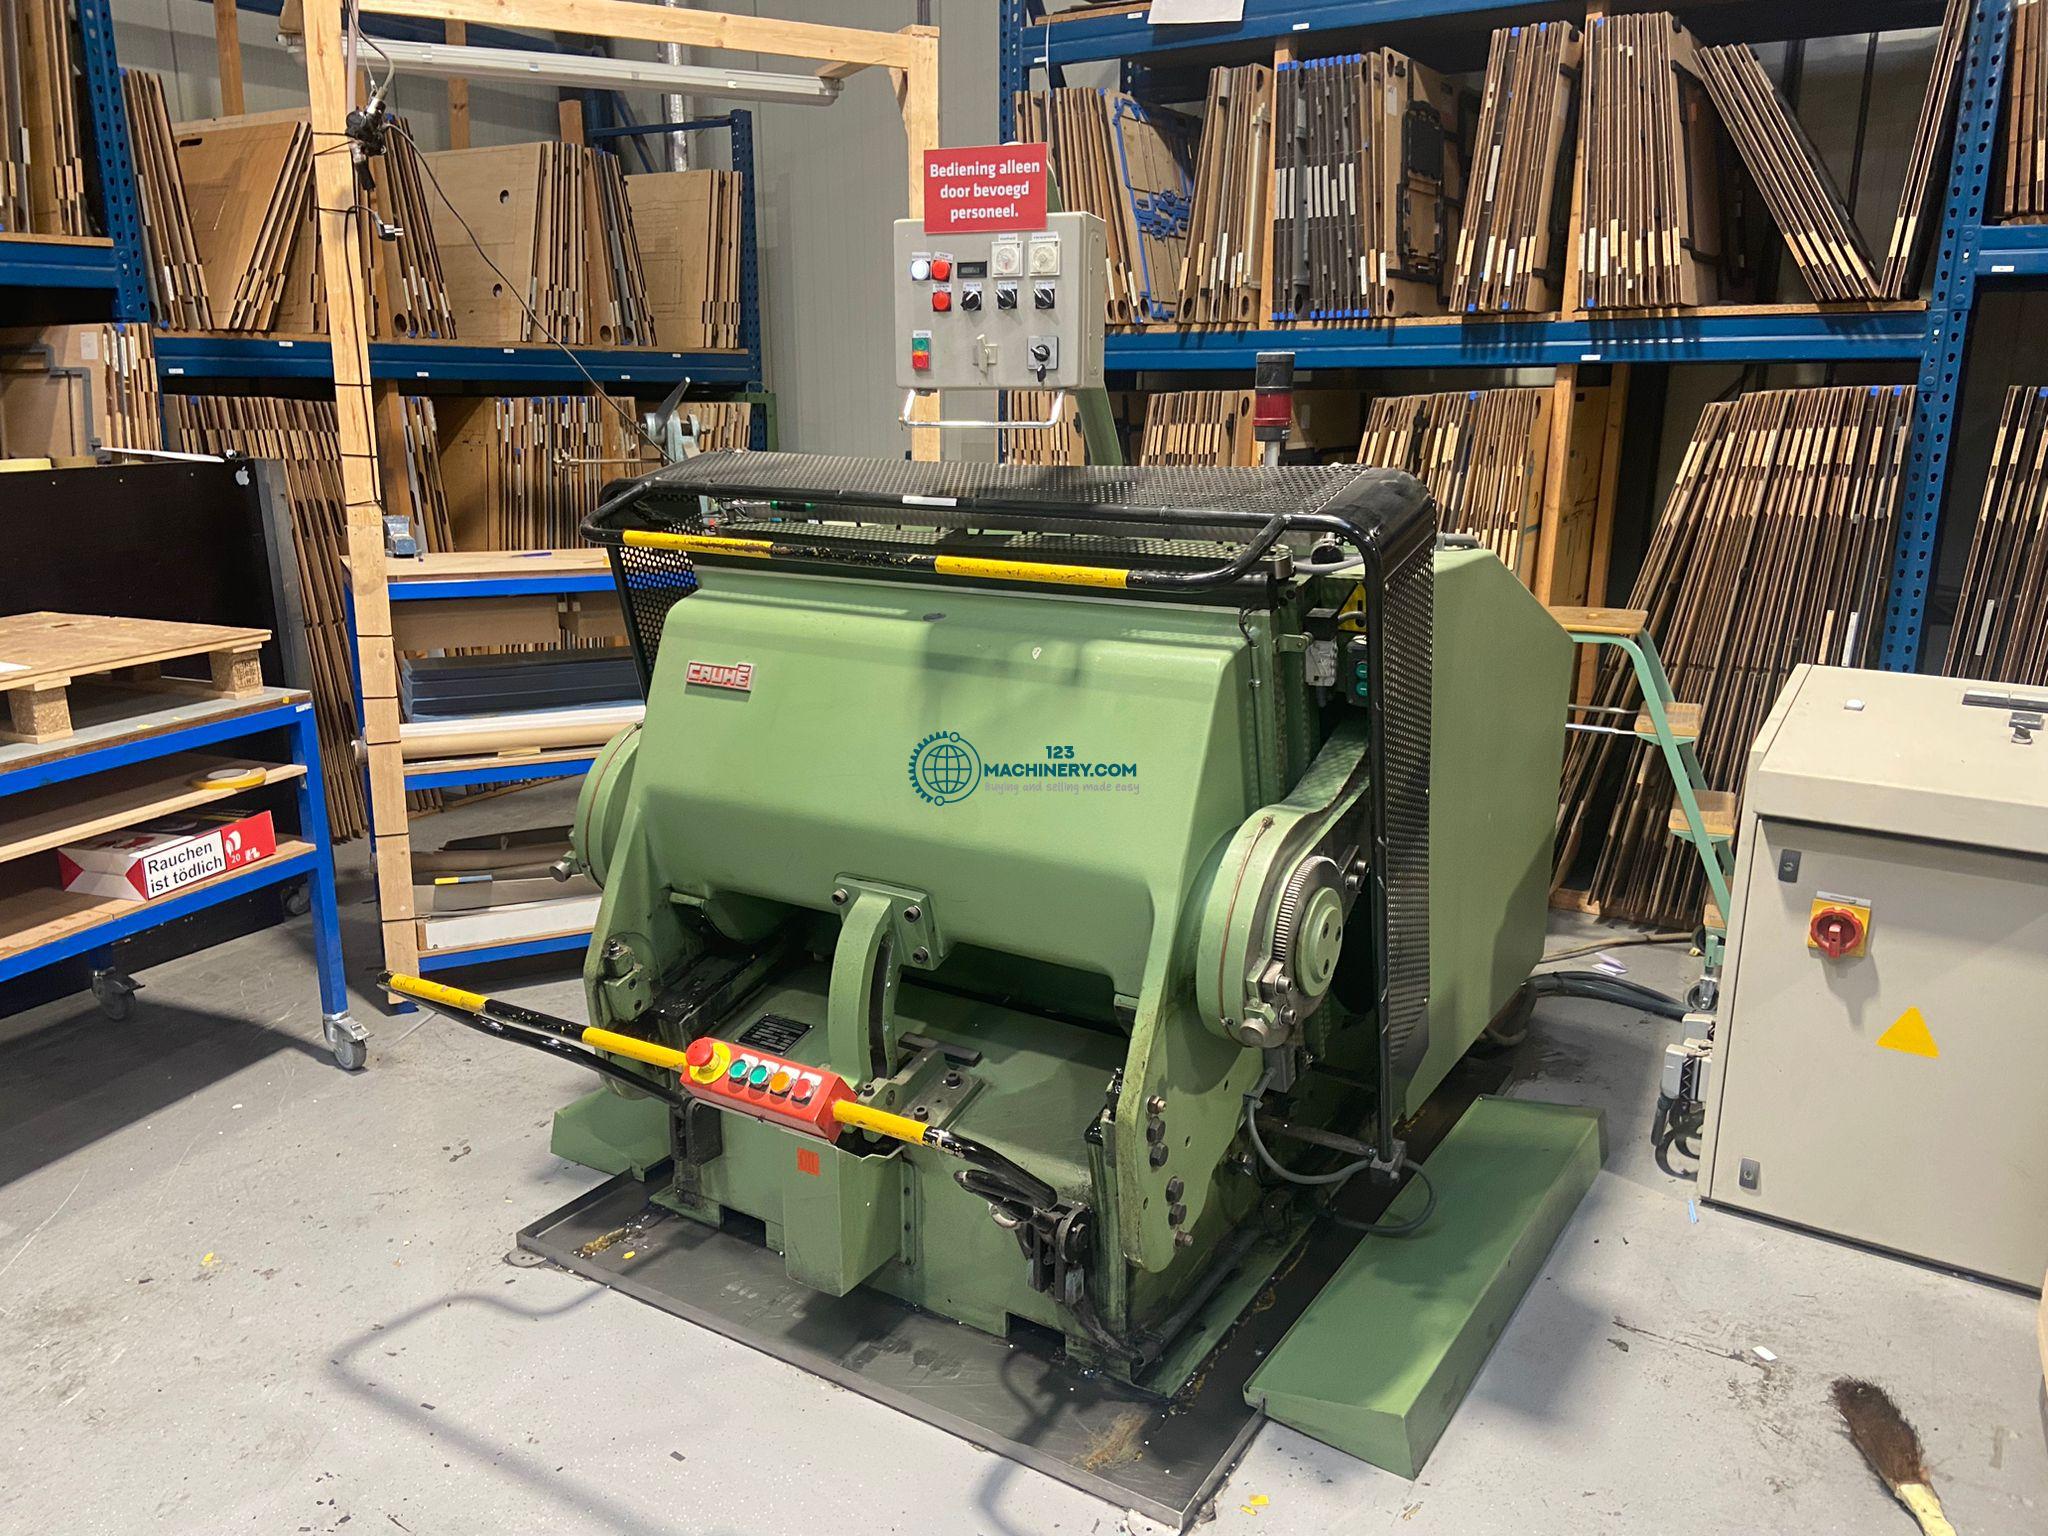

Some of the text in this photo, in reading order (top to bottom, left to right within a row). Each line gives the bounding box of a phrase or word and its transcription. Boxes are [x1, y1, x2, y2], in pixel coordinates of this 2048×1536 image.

[930, 160, 1040, 178] Bediening alleen
[940, 181, 1030, 199] door bevoegd
[950, 203, 1019, 223] personeel.
[148, 842, 213, 874] Rauchen
[231, 853, 241, 864] 20
[150, 856, 223, 893] ist tödlich
